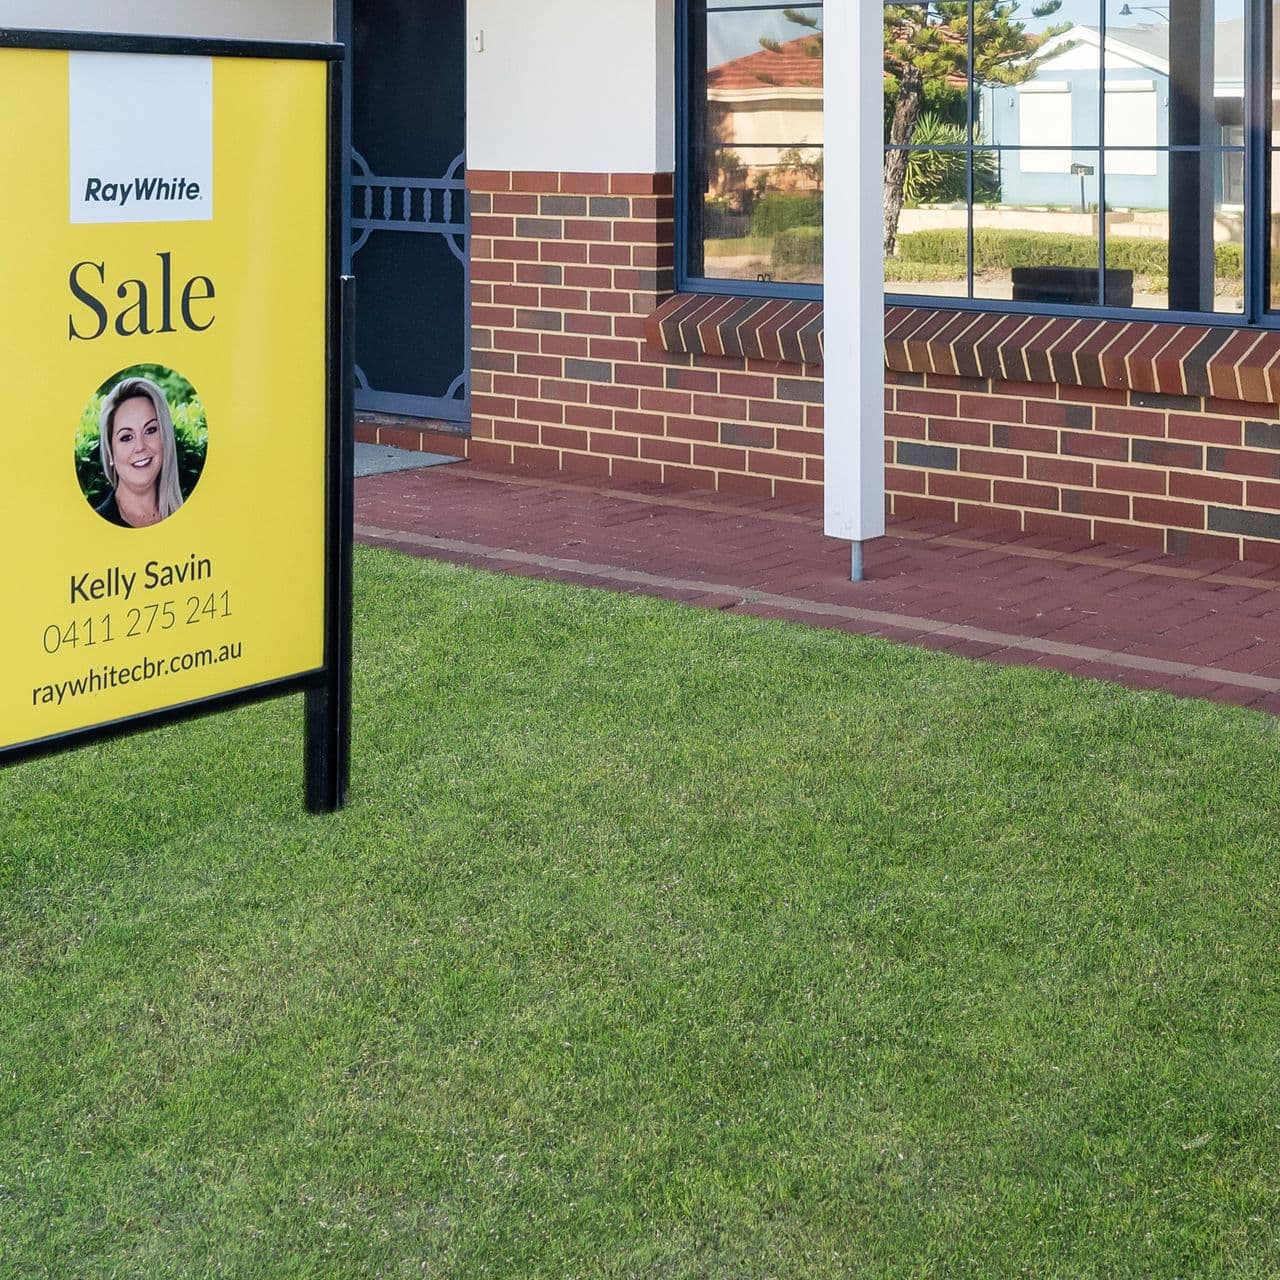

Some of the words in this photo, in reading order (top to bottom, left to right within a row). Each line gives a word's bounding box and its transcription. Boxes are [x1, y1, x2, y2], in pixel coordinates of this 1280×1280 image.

[67, 251, 217, 341] Sale
[70, 566, 137, 604] Kelly
[144, 553, 212, 590] Savin
[43, 613, 115, 654] 0411
[126, 600, 176, 637] 275
[185, 589, 233, 625] 241
[32, 641, 243, 706] raywhitecbr.com.au
